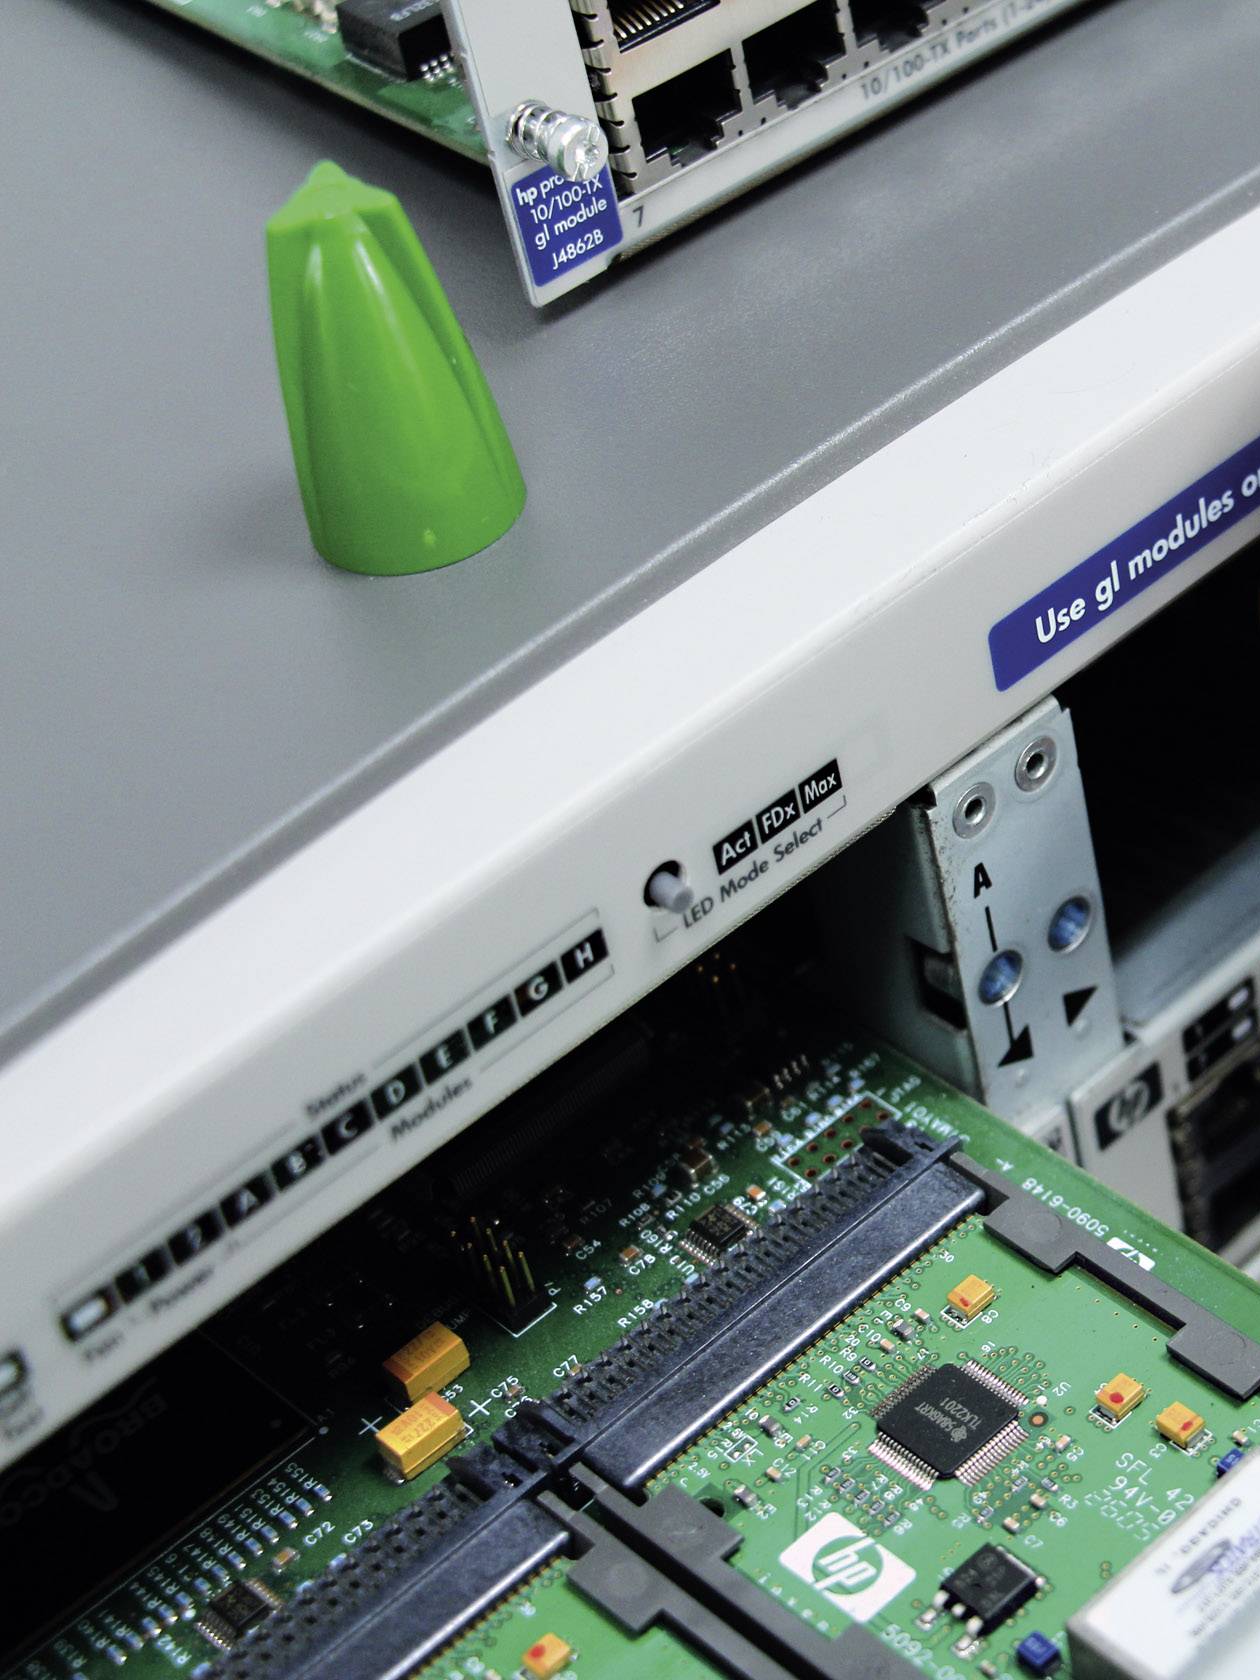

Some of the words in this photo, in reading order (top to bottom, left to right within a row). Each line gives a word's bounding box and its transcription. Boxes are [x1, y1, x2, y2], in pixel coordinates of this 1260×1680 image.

[860, 43, 949, 99] 10/100-TX
[516, 186, 538, 206] hp
[540, 176, 566, 199] pro
[530, 175, 603, 224] 10/100-TX
[535, 224, 550, 250] gl
[554, 197, 608, 235] module
[632, 205, 644, 228] 7
[552, 229, 604, 270] J4862B
[1035, 597, 1086, 643] Use
[1095, 561, 1120, 611] gl
[1128, 490, 1234, 581] modules
[719, 830, 752, 866] Act
[761, 801, 796, 834] FDx
[803, 773, 837, 804] Max
[683, 897, 714, 928] LED
[720, 859, 769, 903] Mode
[774, 818, 823, 862] Select
[973, 862, 992, 898] A
[339, 1113, 358, 1137] C
[385, 1079, 406, 1104] D
[437, 1045, 451, 1069] E
[485, 1010, 499, 1035] F
[528, 976, 548, 1000] G
[575, 941, 594, 969] H
[391, 1077, 473, 1141] Modules
[1022, 1177, 1109, 1237] 5090-6148
[575, 1239, 601, 1261] C54
[572, 1285, 608, 1315] R157
[617, 1299, 654, 1329] R158
[894, 1299, 912, 1312] C9
[981, 1309, 998, 1324] C8
[839, 1347, 857, 1361] R9
[845, 1335, 860, 1347] 20
[553, 1354, 578, 1378] C77
[819, 1355, 843, 1374] R10
[491, 1376, 519, 1399] C75
[800, 1374, 822, 1393] R11
[1052, 1381, 1072, 1397] U2
[940, 1397, 982, 1430] TLK2201
[267, 1477, 301, 1504] R154
[285, 1463, 318, 1489] R155
[1115, 1452, 1152, 1485] SFL
[1166, 1487, 1195, 1512] 42
[1109, 1476, 1177, 1525] 94V-0
[235, 1503, 268, 1529] R151
[304, 1521, 335, 1546] C72
[343, 1519, 374, 1545] C73
